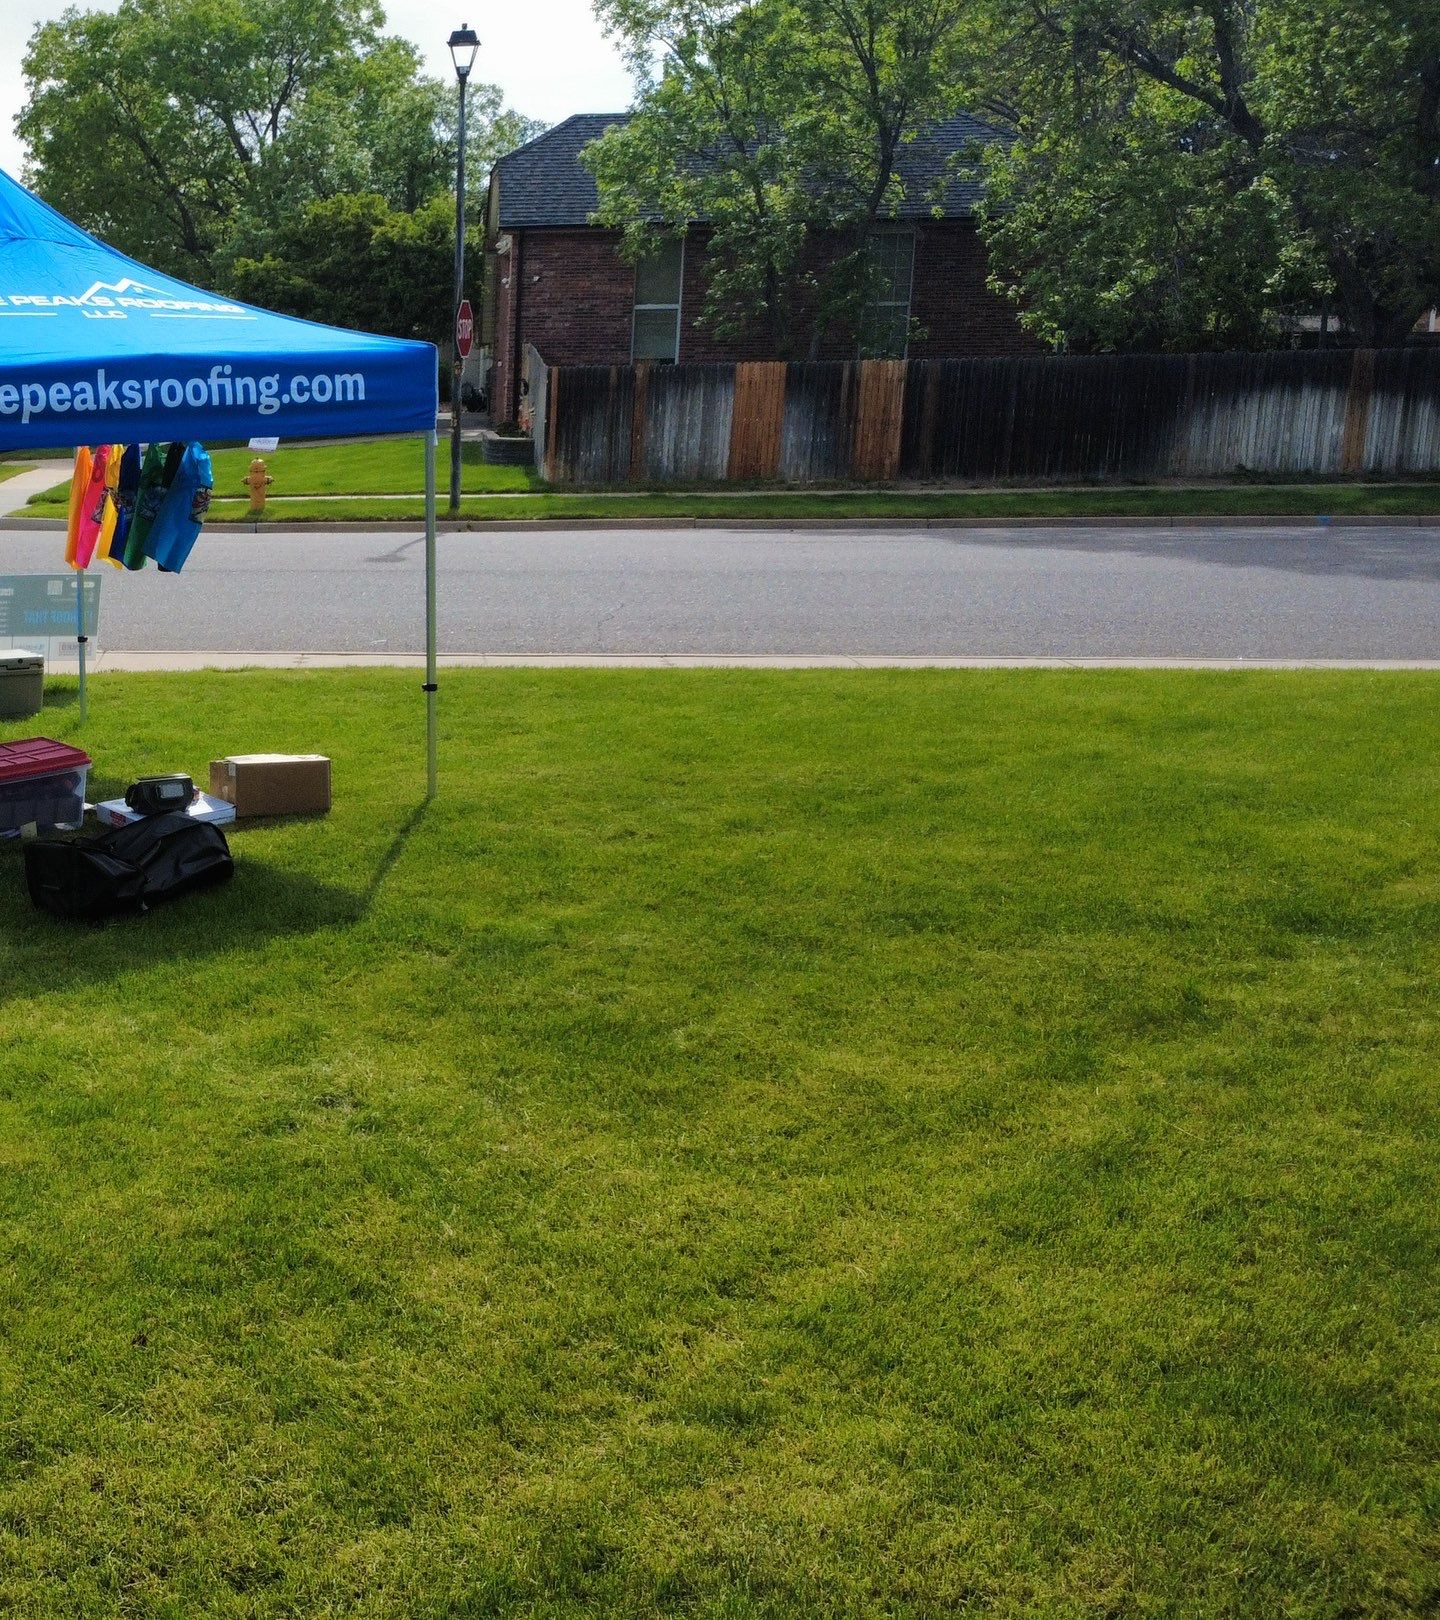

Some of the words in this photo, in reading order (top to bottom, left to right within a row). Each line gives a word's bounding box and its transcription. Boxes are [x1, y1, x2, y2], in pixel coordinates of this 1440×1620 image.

[10, 295, 115, 308] PEAKS
[116, 298, 247, 314] ROOFING
[81, 310, 128, 319] LLC
[458, 318, 473, 339] STOP
